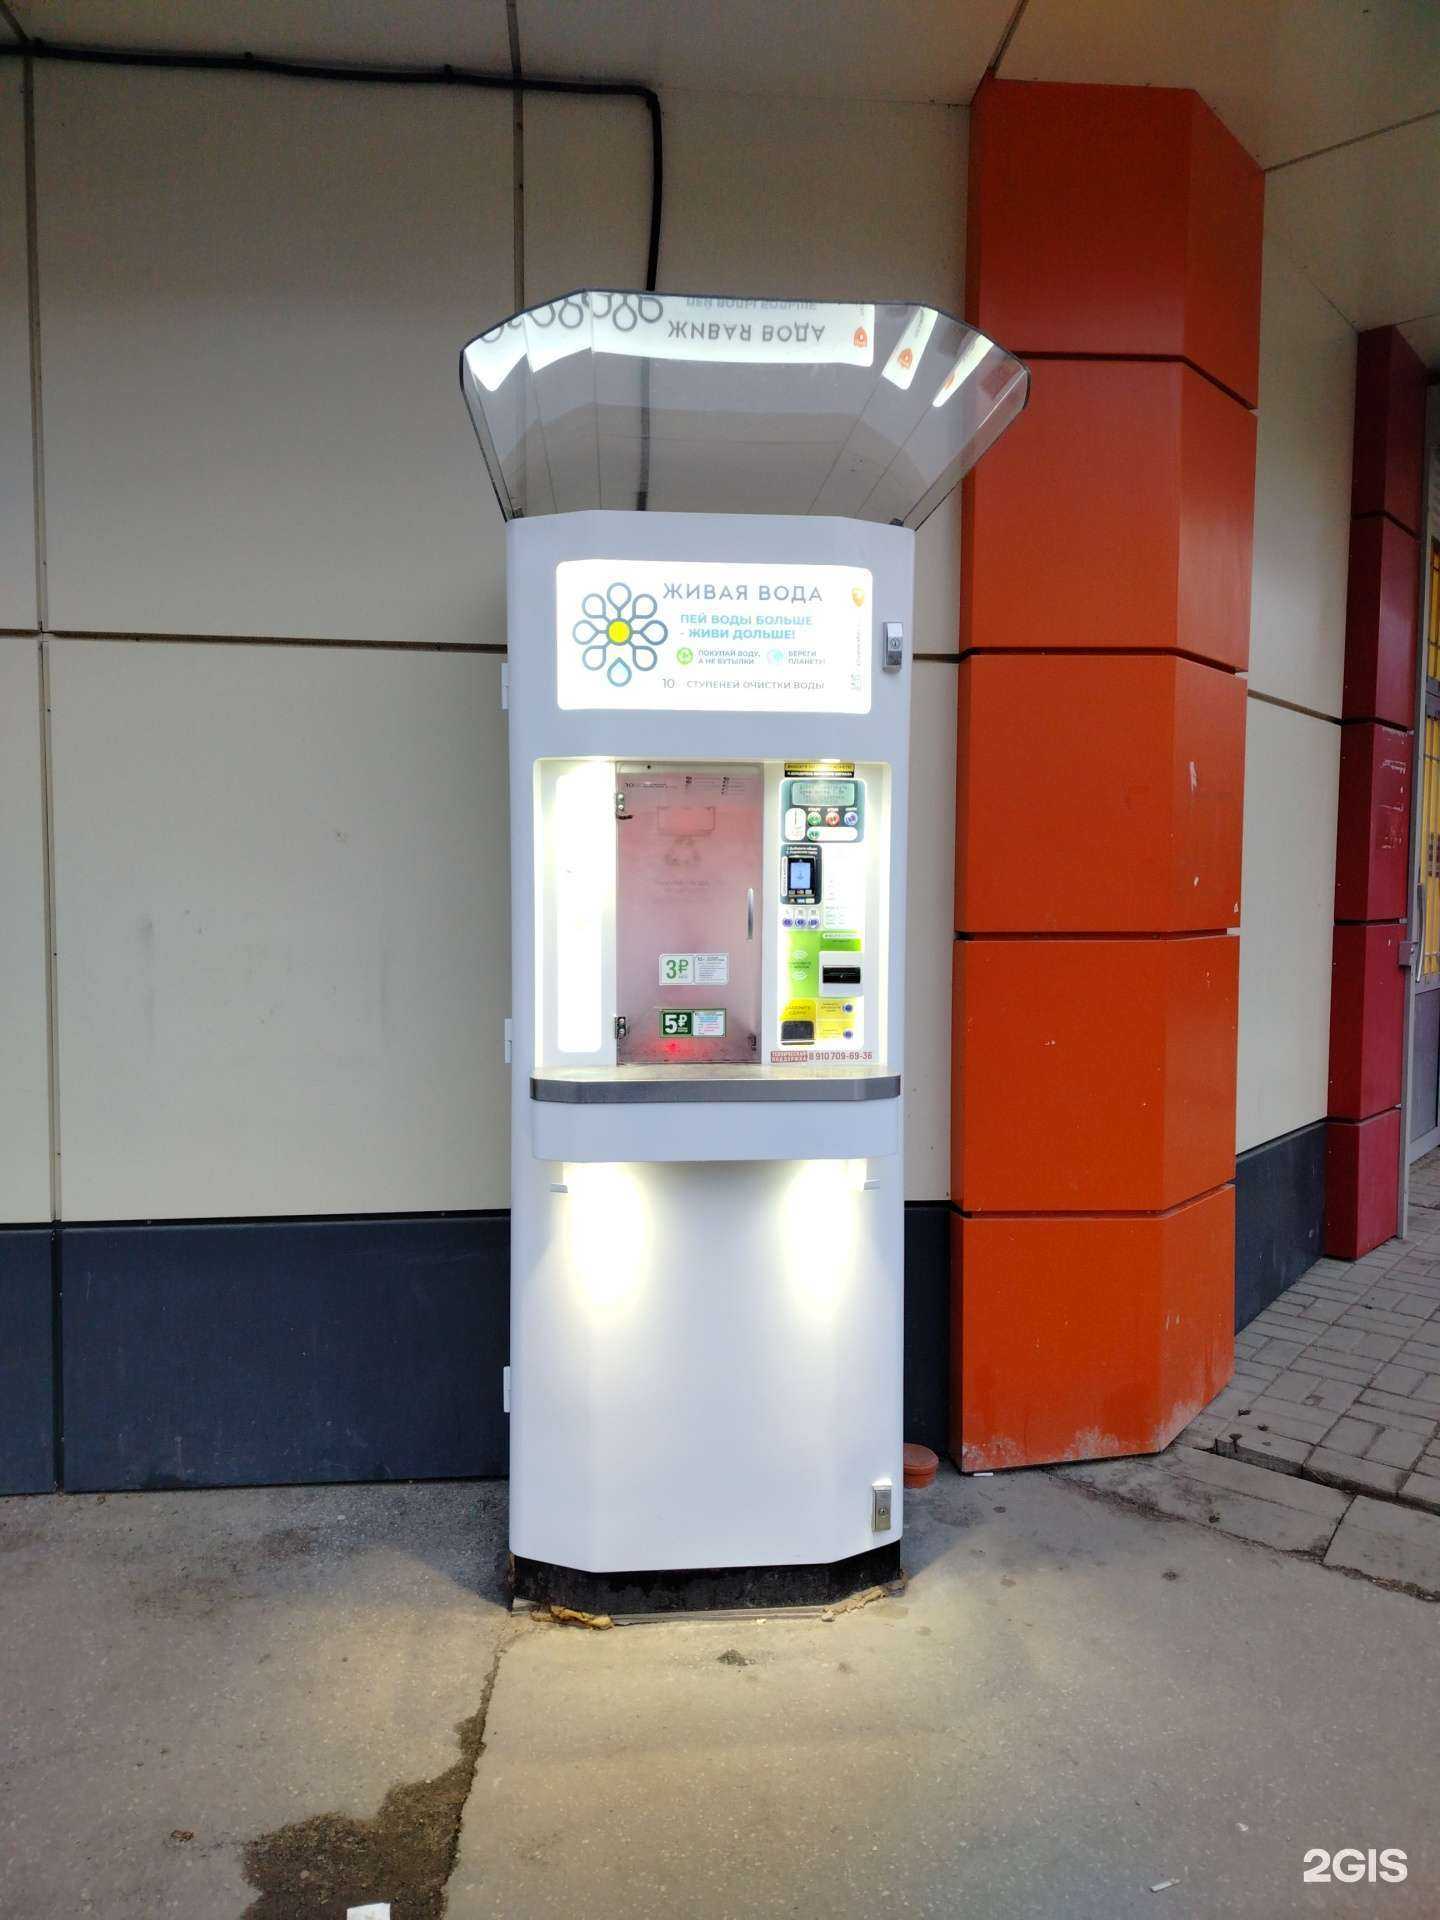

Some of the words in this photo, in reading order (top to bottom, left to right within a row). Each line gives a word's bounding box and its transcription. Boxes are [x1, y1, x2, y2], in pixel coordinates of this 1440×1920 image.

[663, 582, 748, 600] ЖИВАЯ
[758, 585, 823, 603] ВОДА
[680, 613, 707, 624] ПЕЙ
[711, 615, 752, 626] ВОДЫ
[756, 615, 813, 626] БОЛЬШЕ
[688, 628, 729, 639] ЖИВИ
[732, 629, 796, 640] ДОЛЬШЕ!
[815, 1052, 829, 1060] 910
